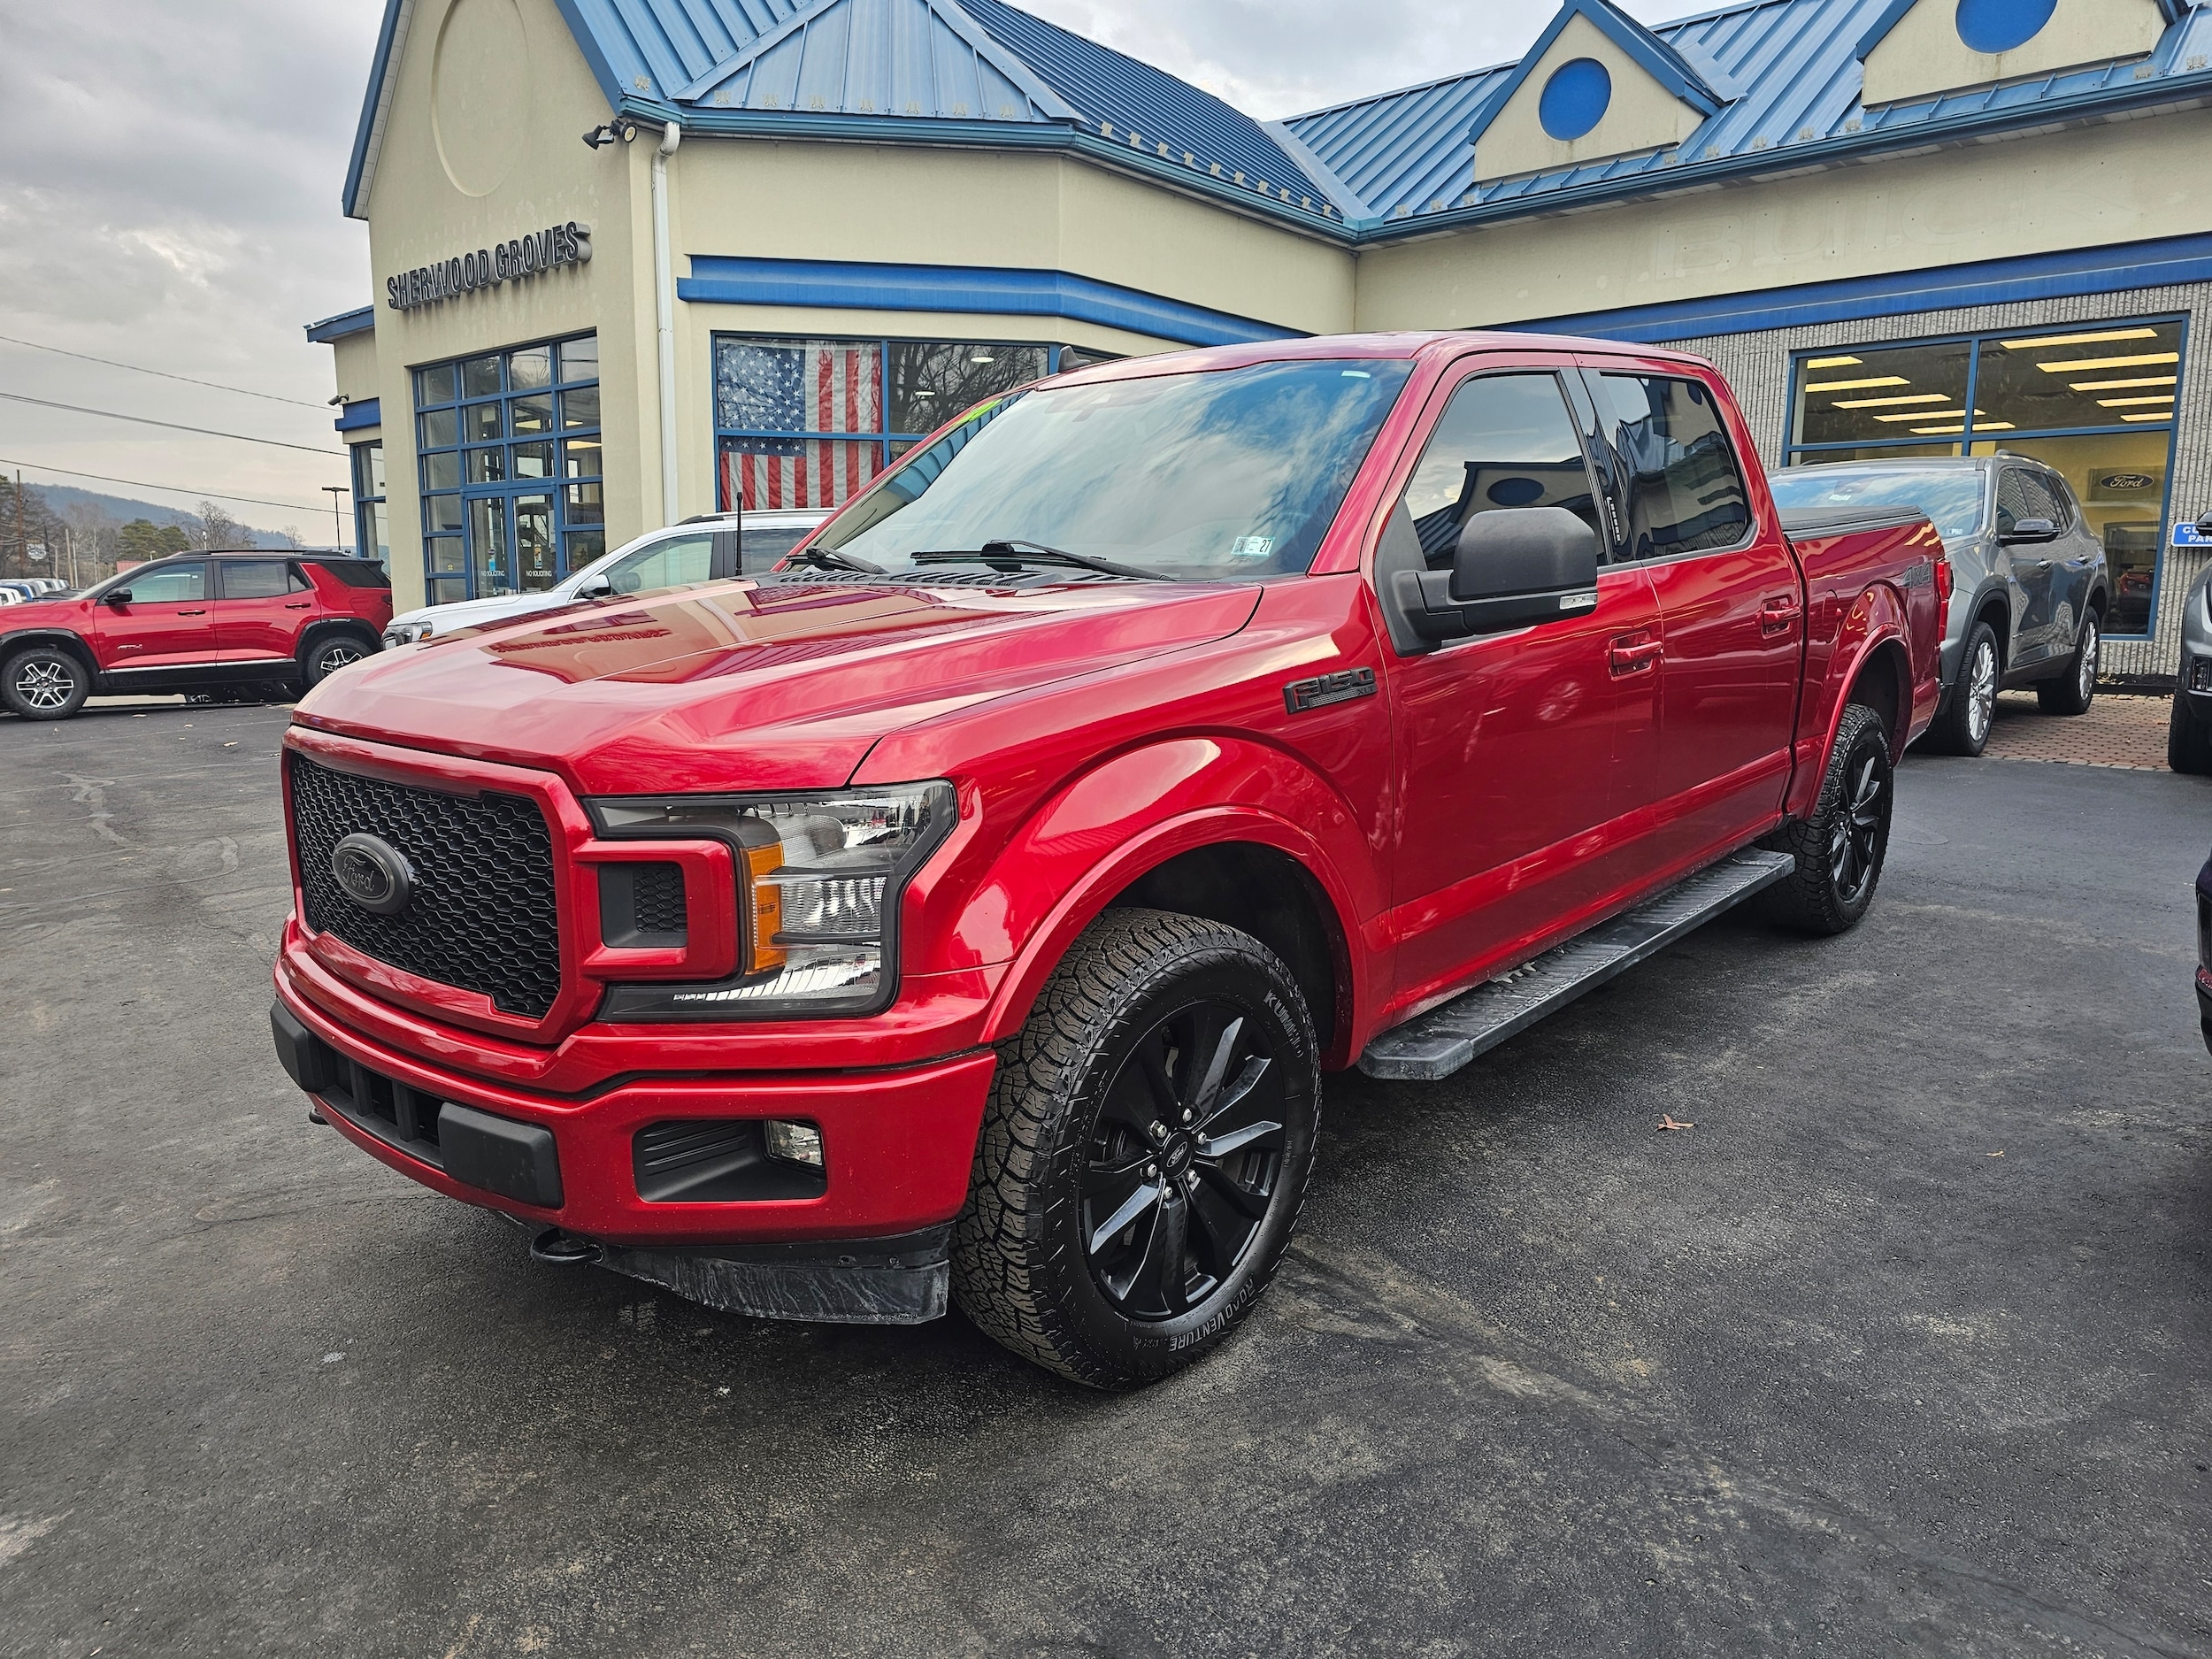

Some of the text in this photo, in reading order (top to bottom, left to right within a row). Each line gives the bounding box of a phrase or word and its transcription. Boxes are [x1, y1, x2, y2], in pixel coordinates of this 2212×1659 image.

[387, 221, 592, 310] SHERWOOD GROVES
[2110, 475, 2144, 487] Ford
[1260, 539, 1272, 553] 27
[341, 855, 375, 892] Ford
